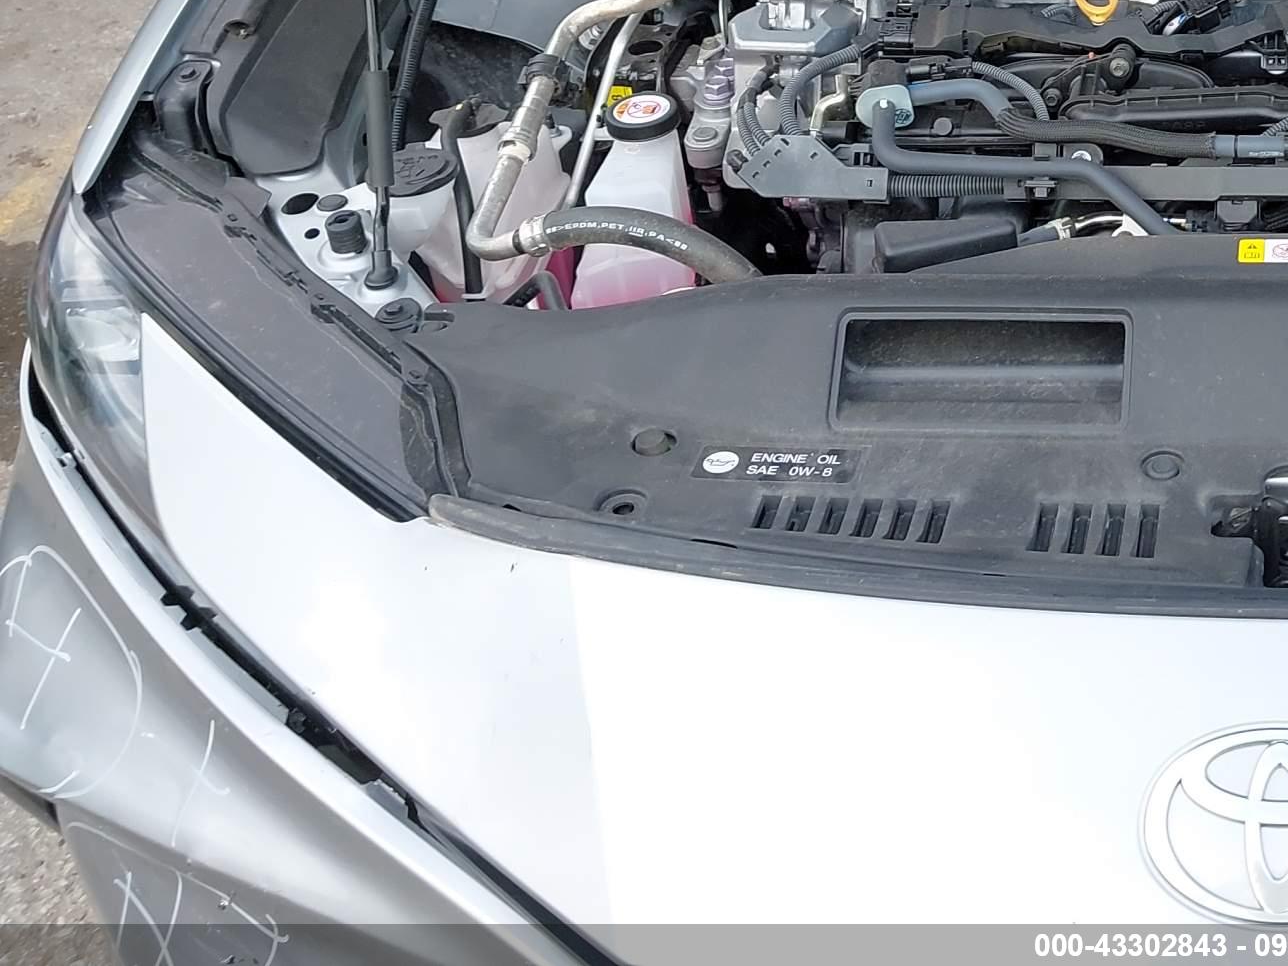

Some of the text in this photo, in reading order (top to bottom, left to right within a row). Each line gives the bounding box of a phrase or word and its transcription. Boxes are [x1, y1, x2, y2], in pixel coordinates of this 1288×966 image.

[751, 452, 842, 466] ENGINE OIL
[745, 464, 833, 478] SAE 0W-8
